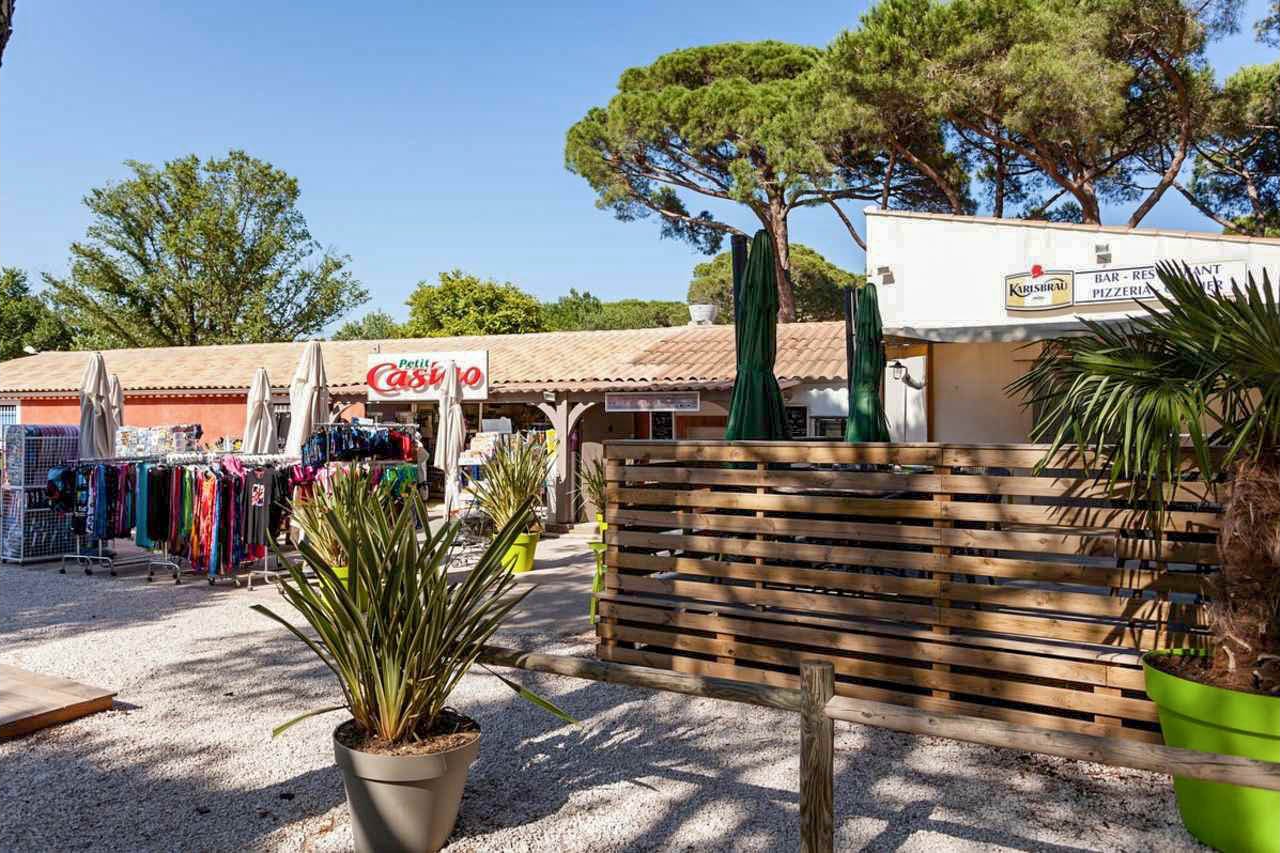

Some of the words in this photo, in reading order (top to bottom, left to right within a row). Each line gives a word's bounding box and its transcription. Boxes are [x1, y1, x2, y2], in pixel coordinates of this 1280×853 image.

[1095, 273, 1120, 283] BAR
[1132, 264, 1222, 281] RESANT
[1093, 285, 1151, 298] PIZZERIA
[399, 359, 430, 369] Petit
